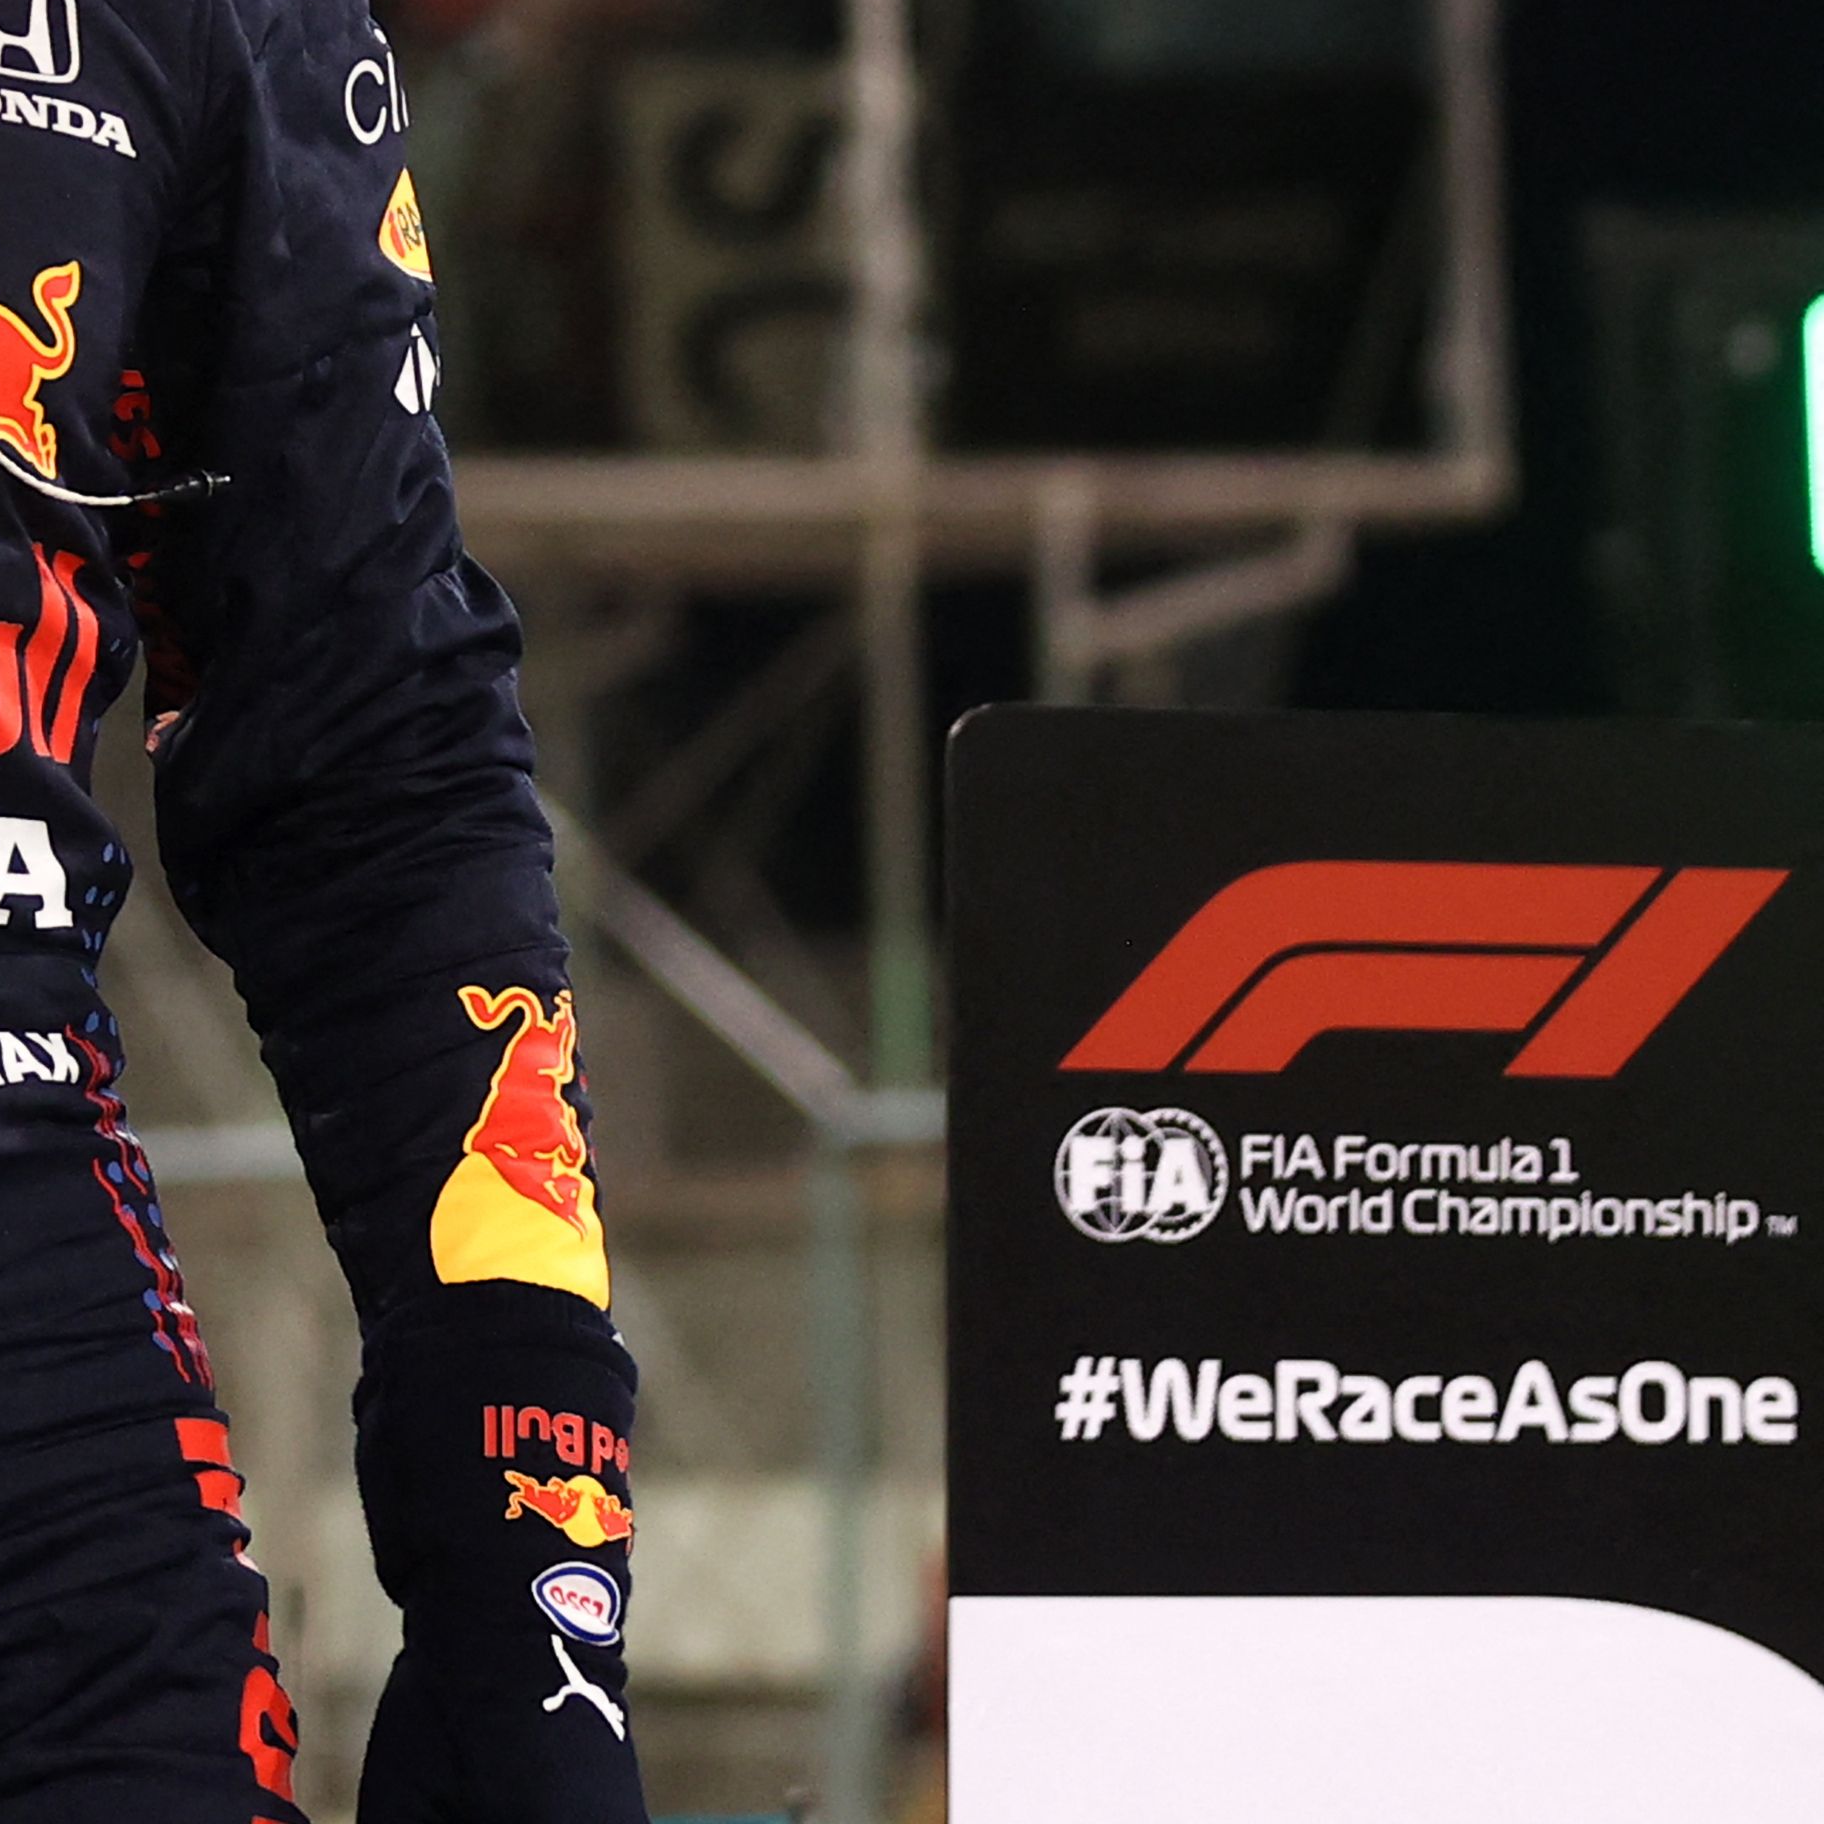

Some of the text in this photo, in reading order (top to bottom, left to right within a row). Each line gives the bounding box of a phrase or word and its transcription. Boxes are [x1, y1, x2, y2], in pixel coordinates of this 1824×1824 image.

[1240, 1134, 1580, 1182] FIA Formula 1
[1239, 1186, 1394, 1234] World
[1401, 1187, 1759, 1244] Championship
[1054, 1355, 1799, 1445] #WeRaceAsOne
[482, 1406, 587, 1467] Bull
